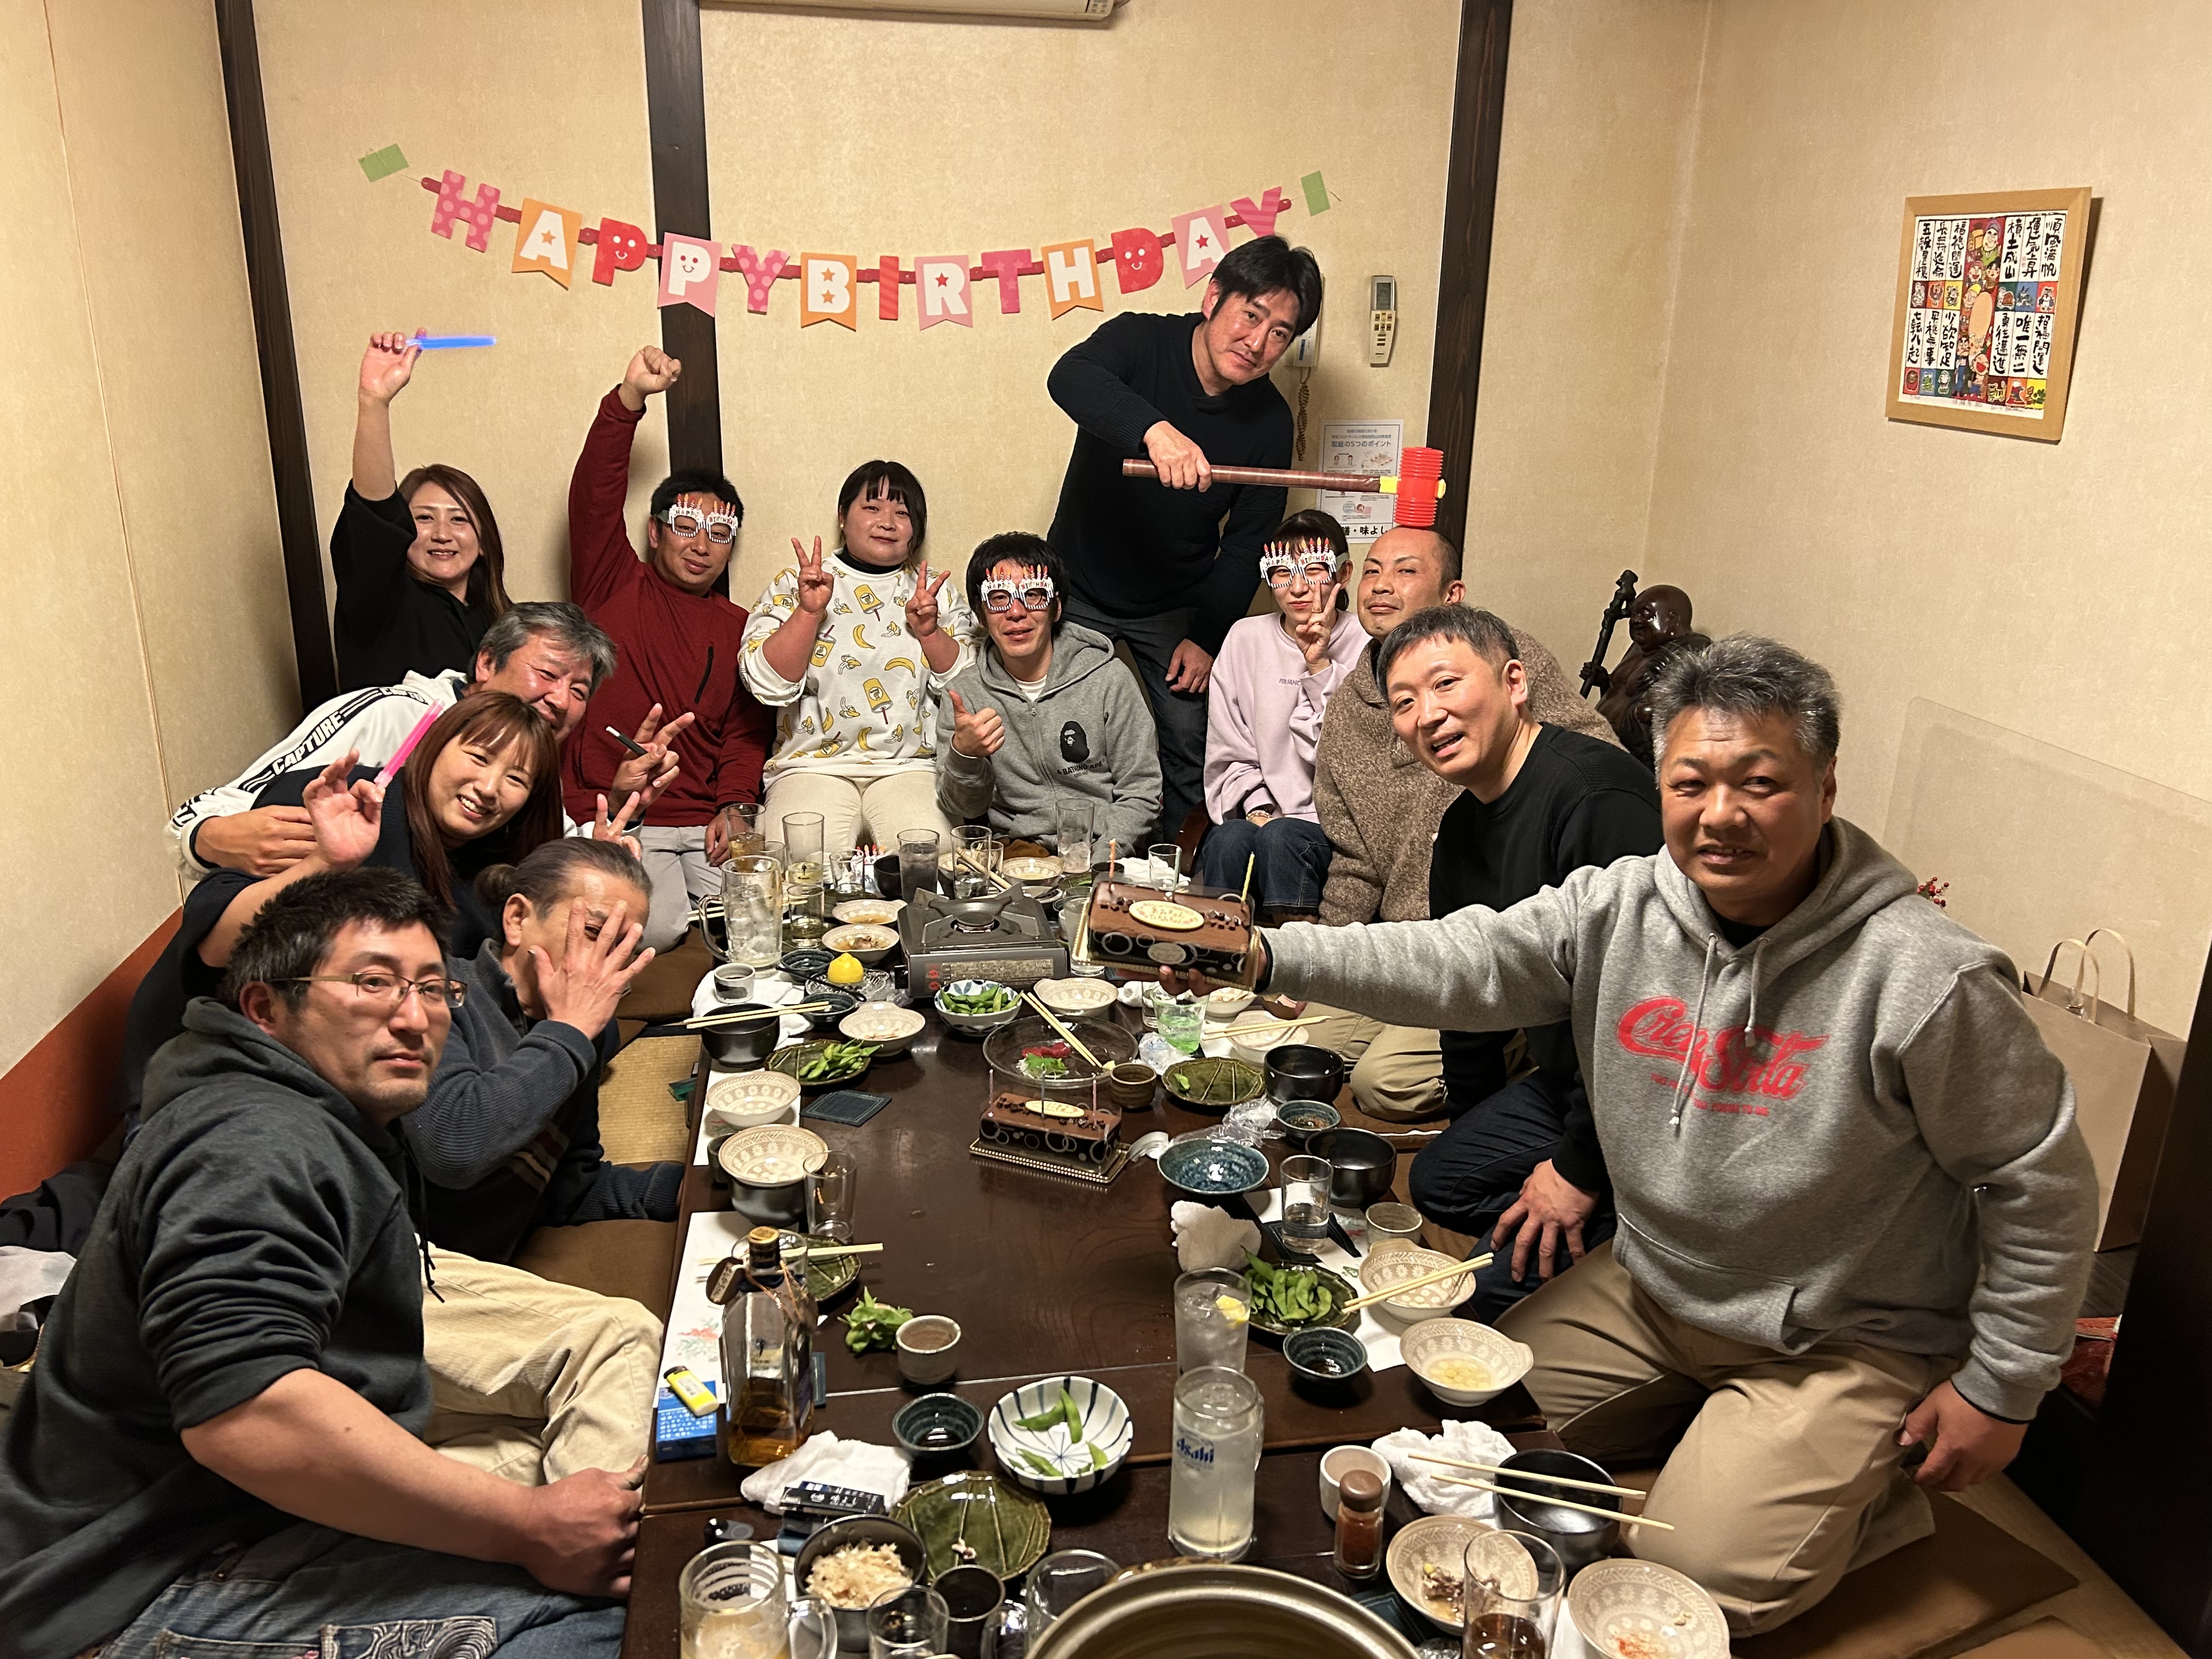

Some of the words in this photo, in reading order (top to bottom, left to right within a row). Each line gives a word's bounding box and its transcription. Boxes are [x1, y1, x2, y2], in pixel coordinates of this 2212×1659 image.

[431, 170, 791, 314] HAPPY
[808, 187, 1281, 320] BIRTHDAY
[2041, 218, 2063, 277] 順風満帆
[1907, 311, 1922, 364] 七転八起
[2012, 314, 2032, 372] 唯一無二
[1300, 554, 1333, 565] BIRTHDAY
[273, 711, 344, 775] CAPTURE
[1176, 1438, 1214, 1463] Asahi
